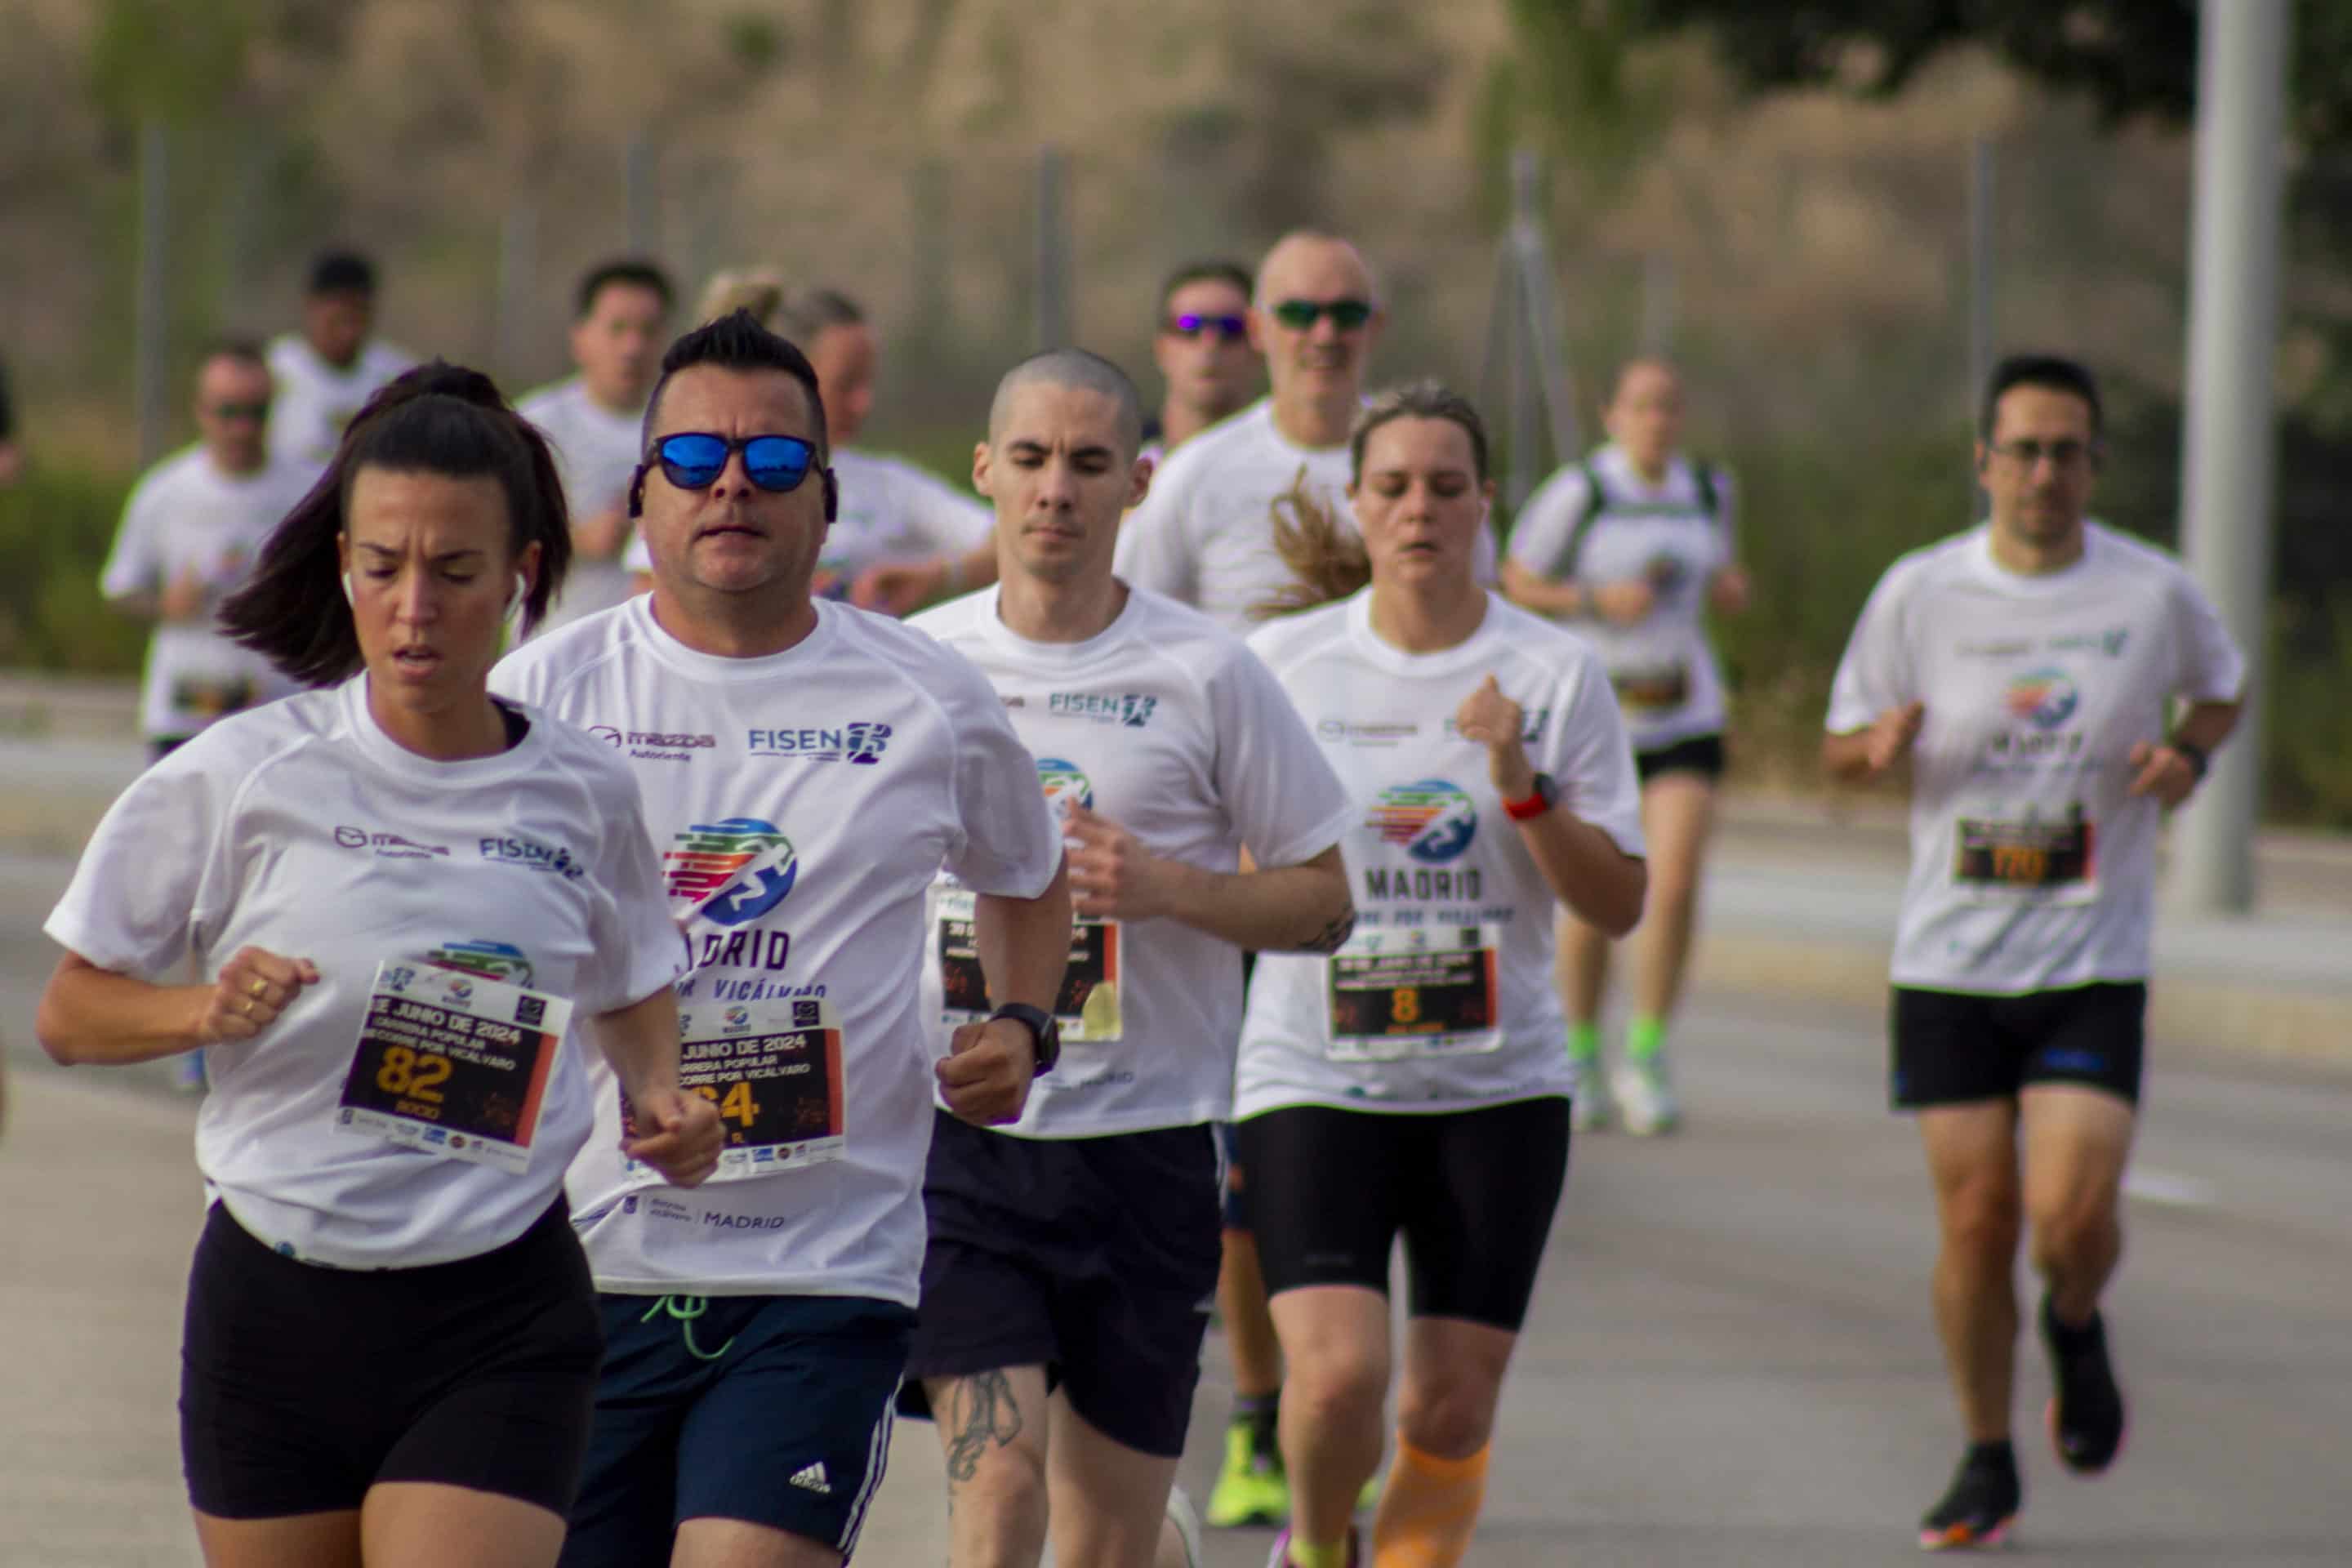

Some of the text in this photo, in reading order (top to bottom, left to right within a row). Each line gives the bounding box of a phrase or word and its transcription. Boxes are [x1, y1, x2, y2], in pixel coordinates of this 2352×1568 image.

[1049, 693, 1119, 713] FISEN
[749, 728, 841, 750] FISEN
[1365, 868, 1483, 901] MADRID
[684, 929, 790, 972] DRID
[1392, 987, 1420, 1022] 8
[392, 1003, 446, 1026] JUNIO
[448, 1013, 474, 1034] DE
[474, 1021, 522, 1045] 2024
[682, 1033, 807, 1061] JUNIO DE 2024
[723, 1054, 778, 1070] POPULAR
[374, 1045, 454, 1103] 82
[717, 1068, 743, 1084] POR
[693, 1081, 760, 1127] 4
[703, 1211, 785, 1230] MADRID
